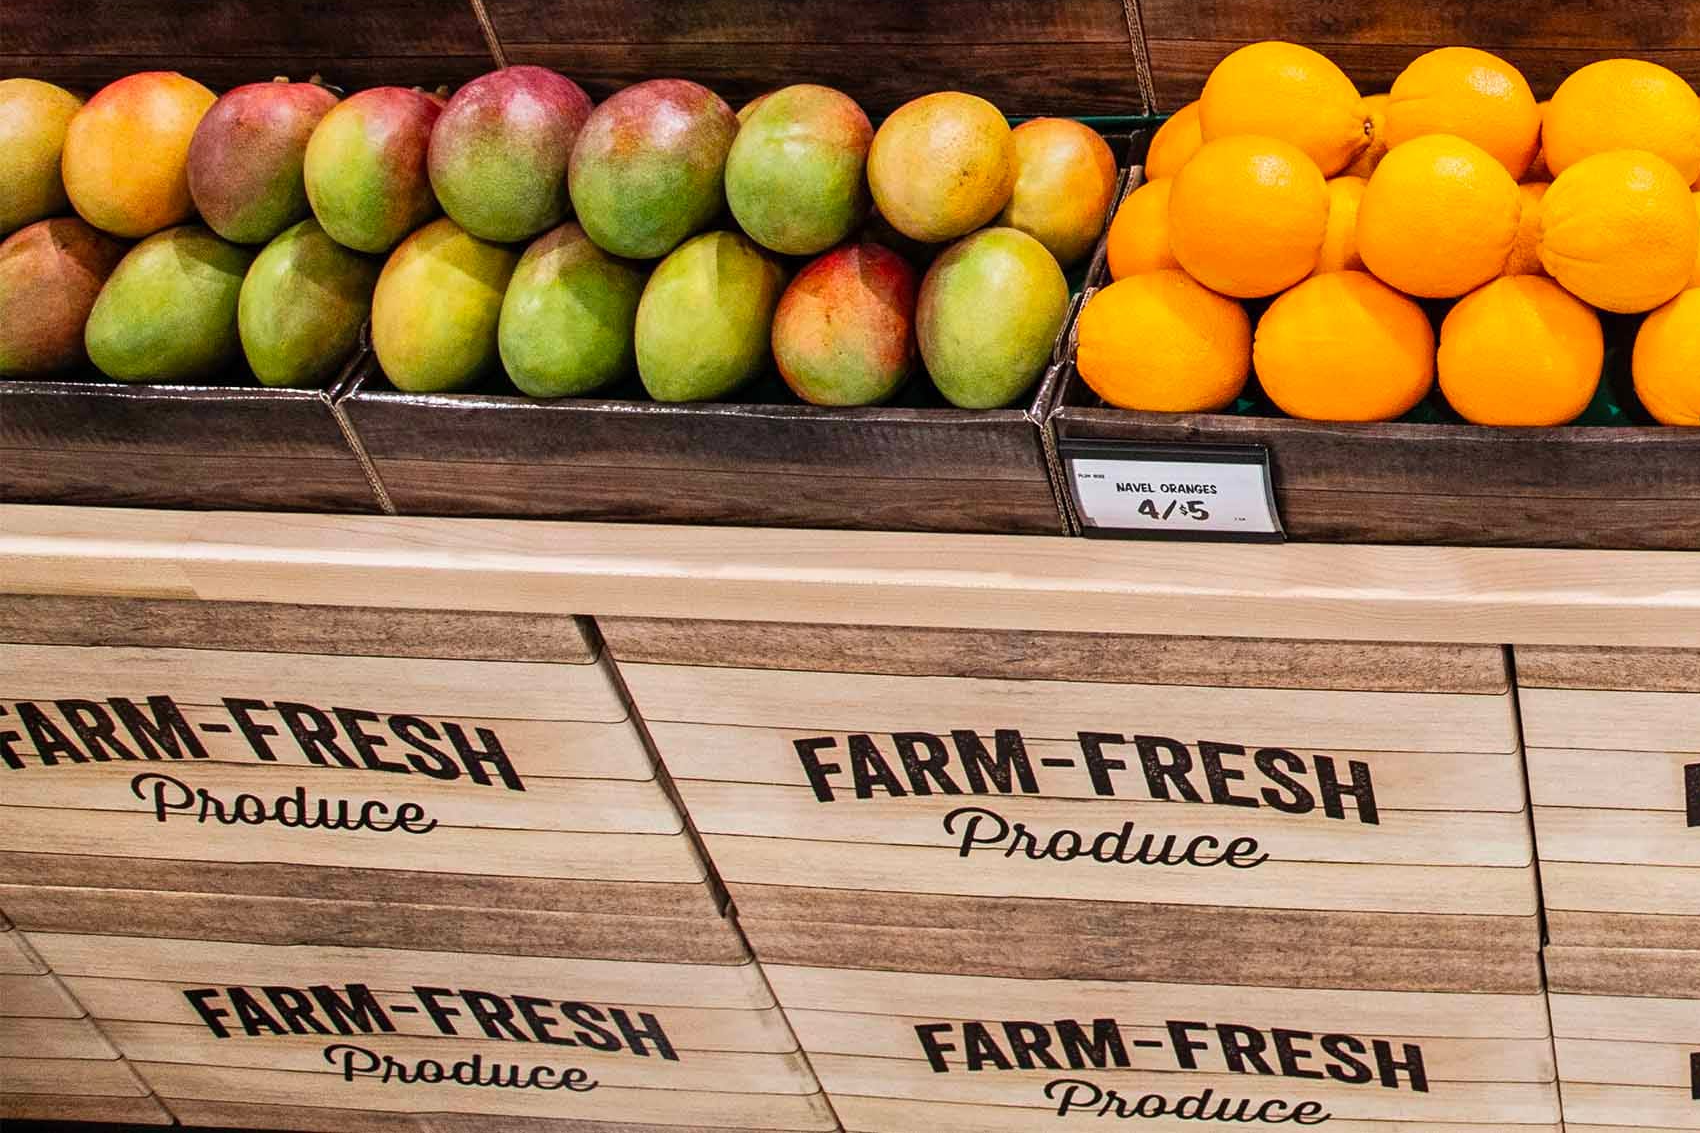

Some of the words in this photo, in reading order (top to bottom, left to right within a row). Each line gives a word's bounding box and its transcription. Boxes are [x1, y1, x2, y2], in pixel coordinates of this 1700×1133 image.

[1116, 482, 1155, 494] NAVEL
[1160, 483, 1217, 495] ORANGES
[1138, 498, 1209, 521] 4/$5
[131, 772, 438, 835] Produce
[793, 729, 1380, 826] FARM-FRESH
[943, 806, 1270, 869] Produce
[183, 983, 680, 1061] FARM-FRESH
[323, 1044, 599, 1092] Produce
[914, 1018, 1431, 1093] FARM-FRESH
[1043, 1078, 1333, 1126] Produce
